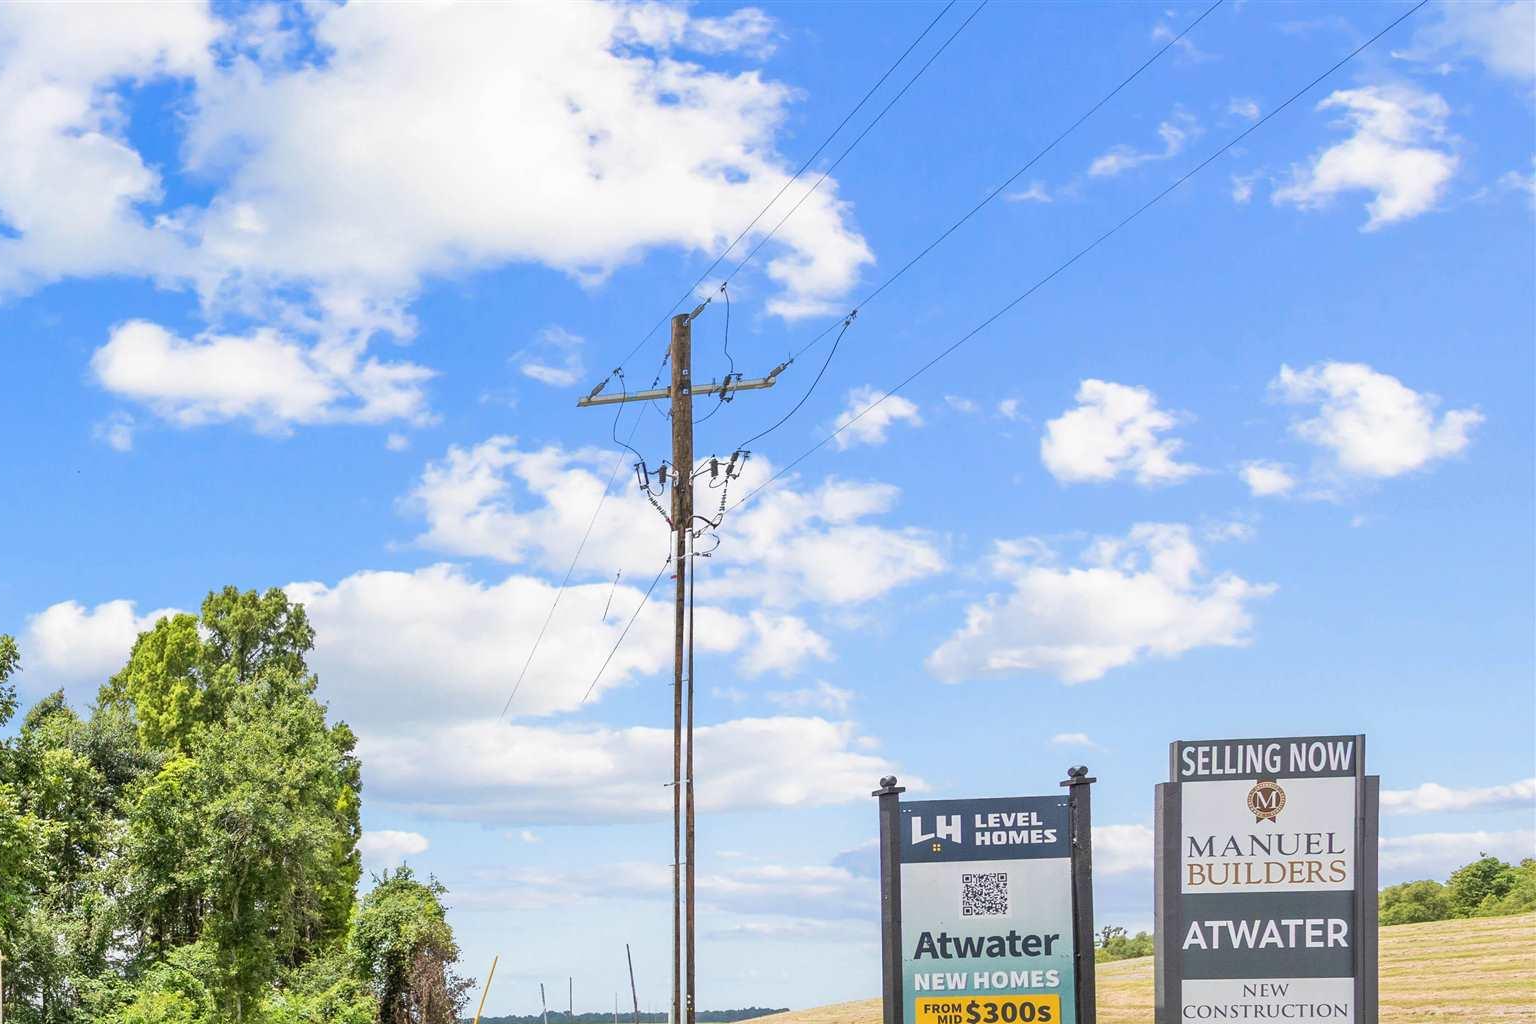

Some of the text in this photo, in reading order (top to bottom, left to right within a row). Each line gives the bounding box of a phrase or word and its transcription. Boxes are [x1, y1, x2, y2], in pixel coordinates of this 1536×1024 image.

[1182, 741, 1353, 776] SELLING NOW
[1256, 790, 1277, 809] M
[911, 814, 962, 845] LH
[975, 812, 1043, 828] LEVEL
[975, 829, 1057, 846] HOMES
[1187, 832, 1345, 858] MANUEL
[1187, 860, 1347, 886] BUILDERS
[1182, 918, 1349, 950] ATWATER
[914, 930, 1060, 960] Atwater
[914, 969, 1061, 991] NEW HOMES
[1243, 983, 1289, 998] NEW
[924, 1003, 962, 1014] FROM
[1183, 1003, 1348, 1019] CONSTRUCTION
[937, 1014, 963, 1024] MID
